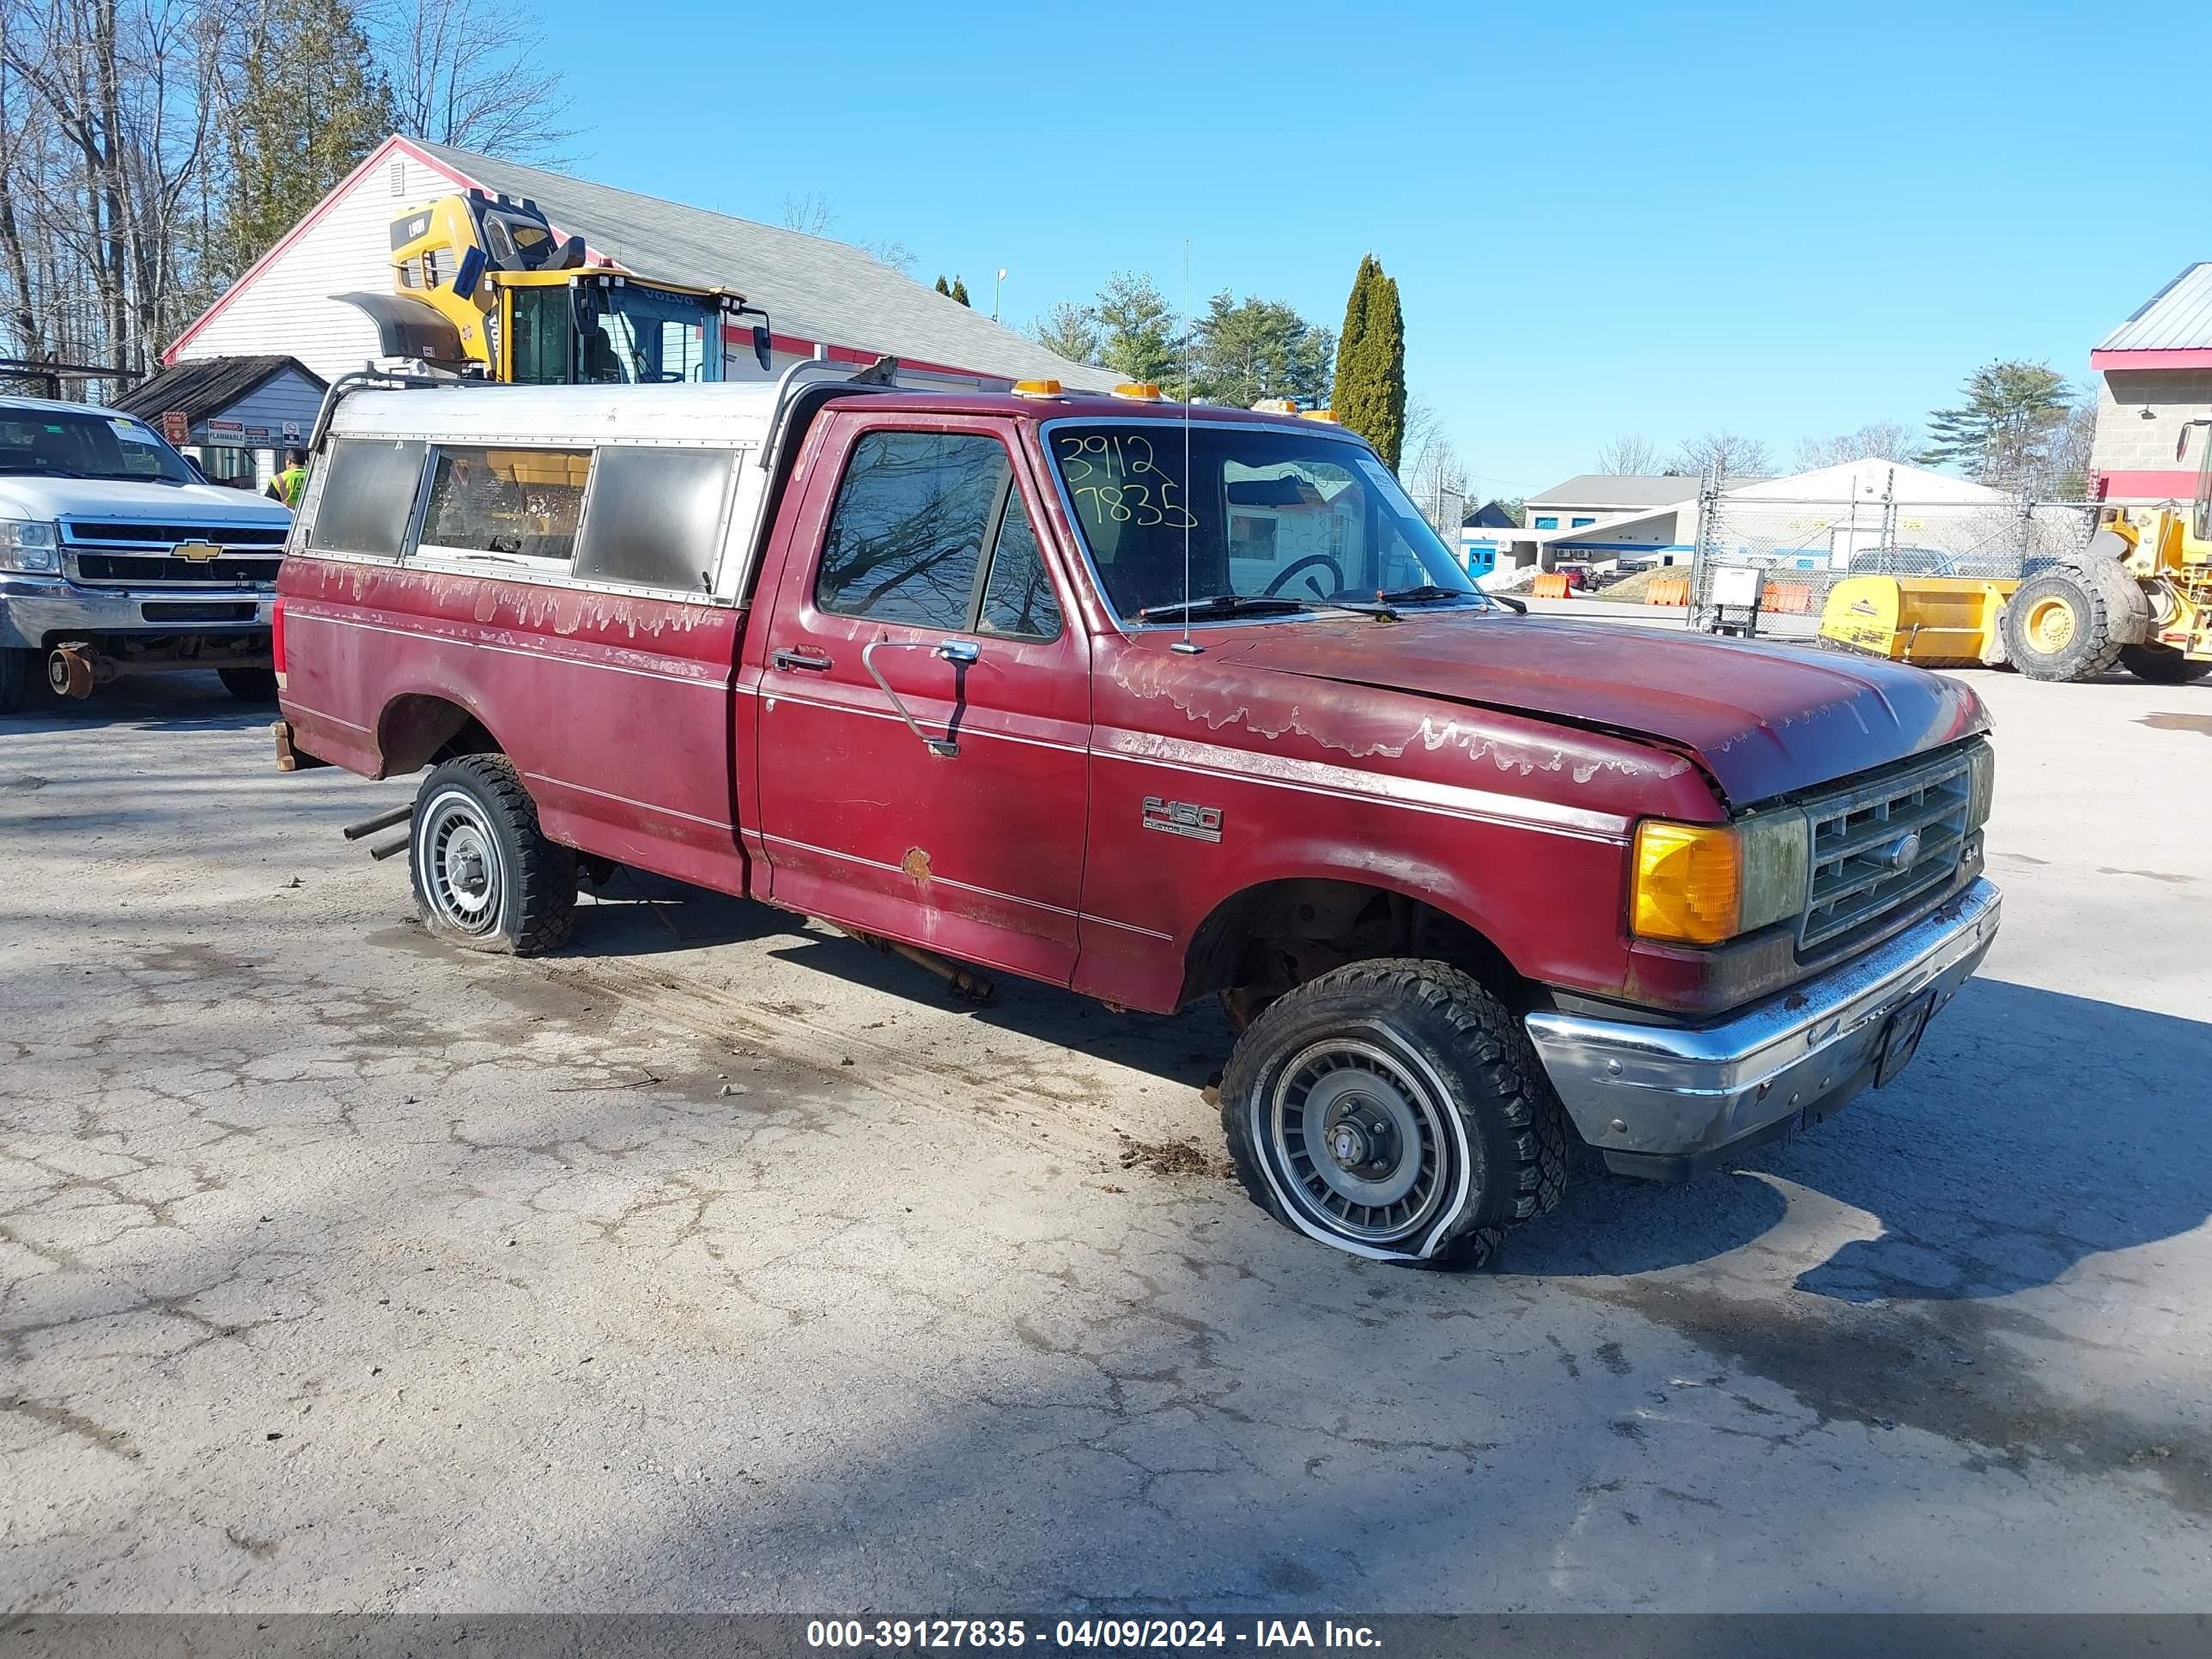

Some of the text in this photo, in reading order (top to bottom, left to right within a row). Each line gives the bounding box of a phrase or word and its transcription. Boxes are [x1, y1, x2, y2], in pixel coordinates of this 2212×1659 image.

[645, 289, 695, 307] VOLVO
[210, 432, 244, 441] FLAMMABLE
[1061, 435, 1173, 482] 3912
[1074, 483, 1199, 528] 7835
[1142, 796, 1223, 829] F-150
[1145, 820, 1181, 832] CUSTOM
